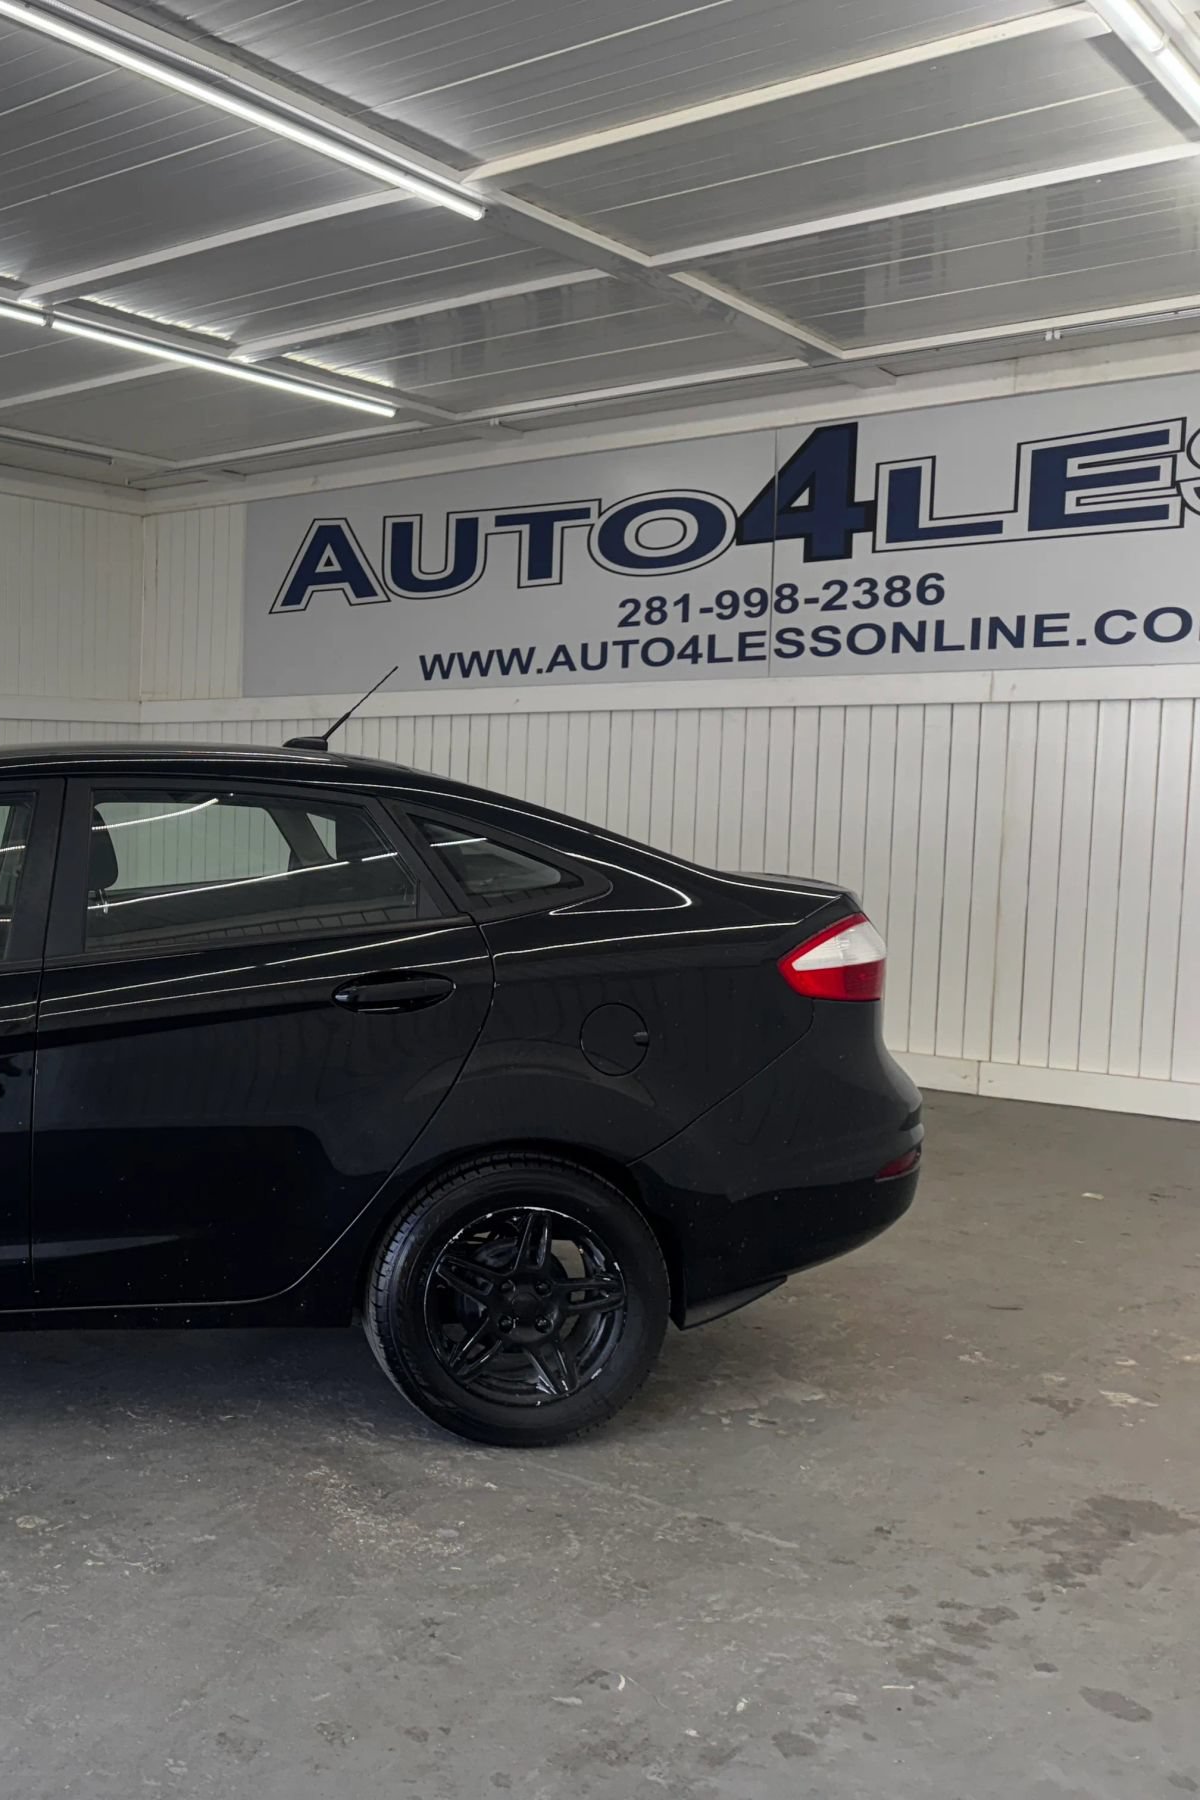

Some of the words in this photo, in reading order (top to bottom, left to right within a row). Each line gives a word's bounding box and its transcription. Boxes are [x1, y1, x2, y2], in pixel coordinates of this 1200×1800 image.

[268, 415, 1200, 615] AUTO4LE
[617, 572, 946, 628] 281-998-2386
[419, 606, 1200, 681] WWW.AUTO4LESSONLINE.CO
